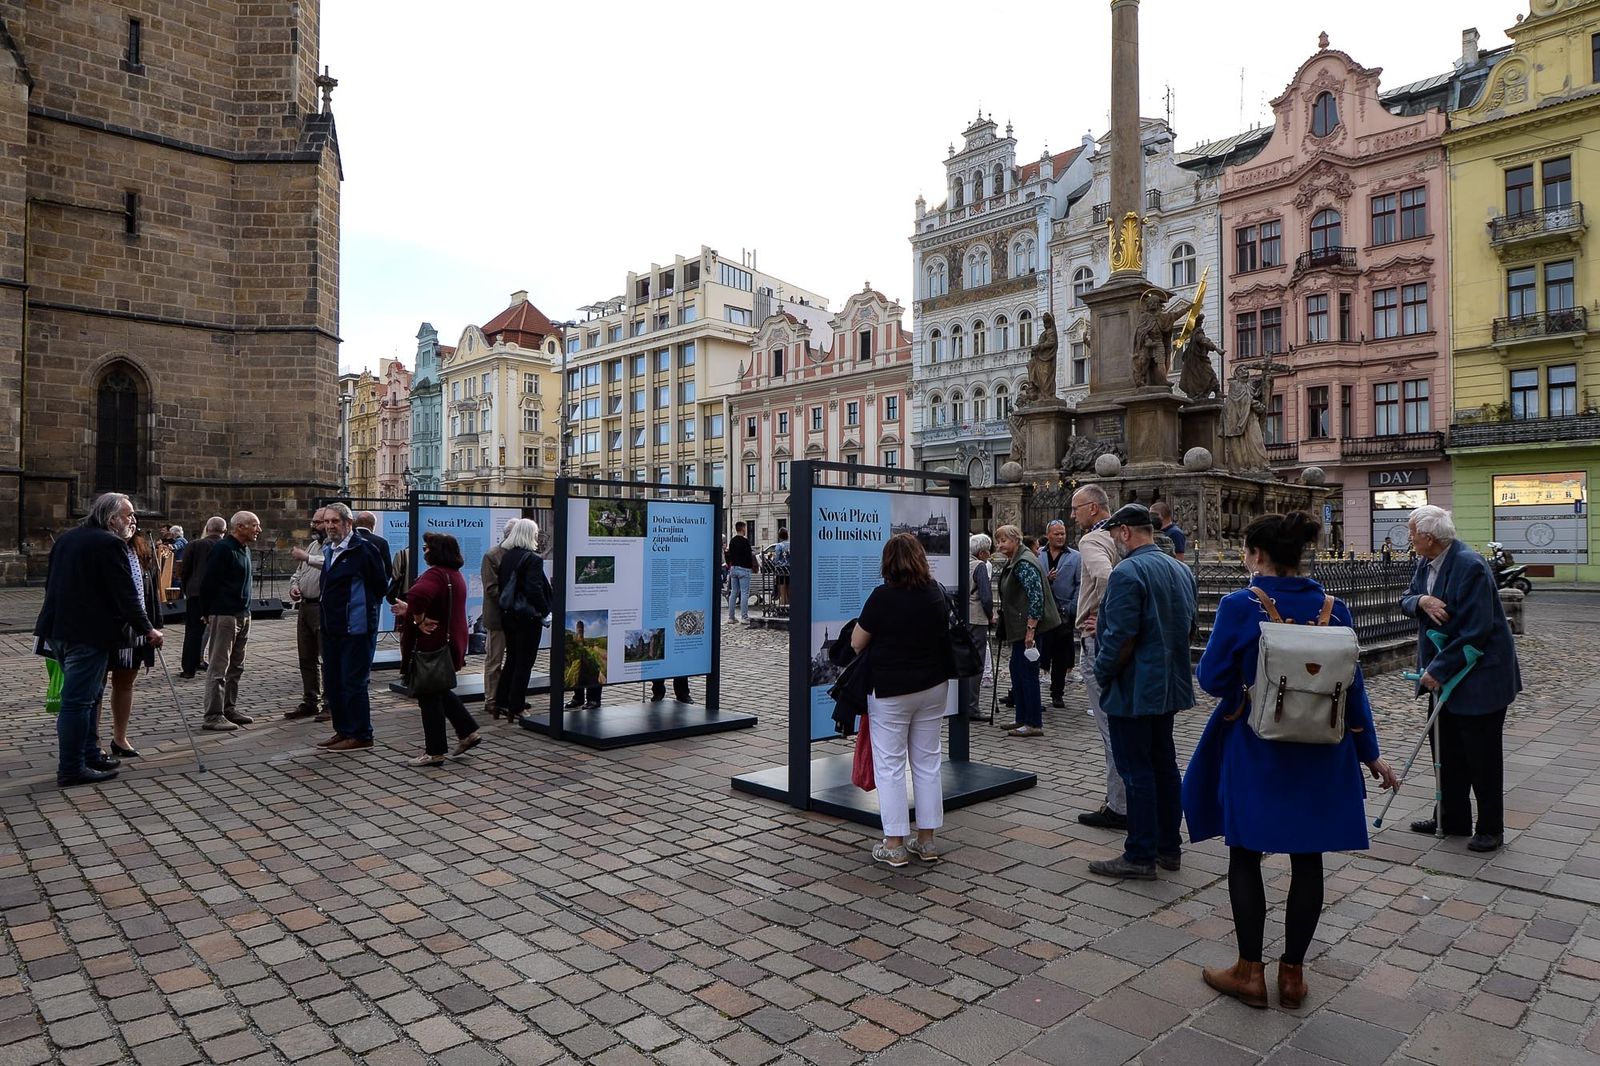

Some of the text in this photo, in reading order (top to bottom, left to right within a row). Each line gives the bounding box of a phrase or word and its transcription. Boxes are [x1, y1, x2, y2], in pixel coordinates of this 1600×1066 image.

[1380, 472, 1412, 484] DAY
[818, 507, 878, 523] Nová Plzeň
[427, 518, 484, 528] Stará Plzeň
[652, 516, 671, 524] Doba
[672, 516, 698, 524] Václava
[658, 526, 684, 535] krajina
[818, 526, 882, 541] do husitství
[652, 535, 688, 544] západních
[652, 543, 670, 552] Čech
